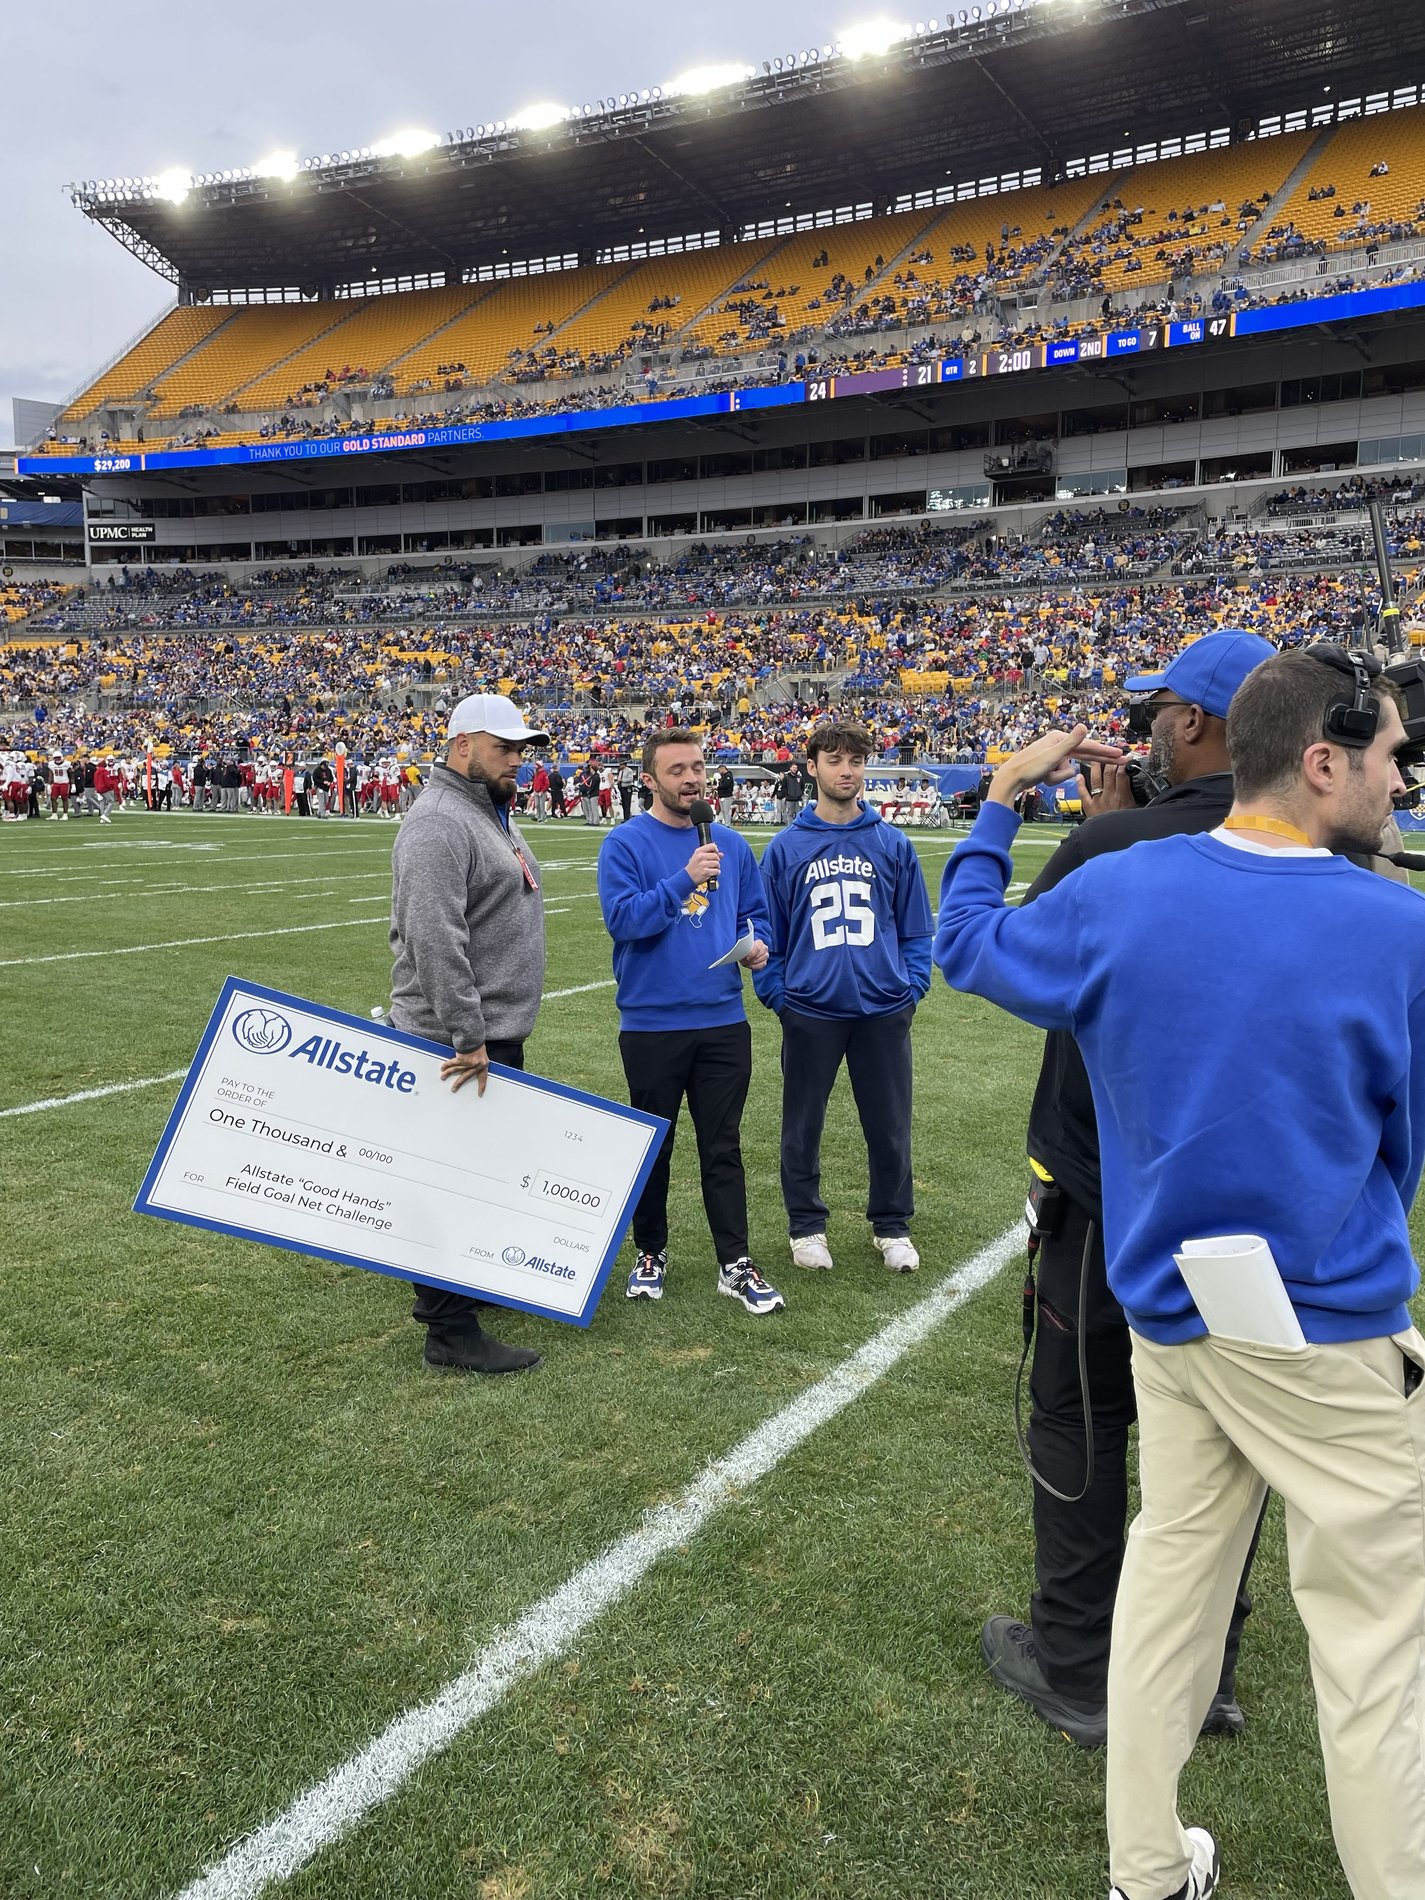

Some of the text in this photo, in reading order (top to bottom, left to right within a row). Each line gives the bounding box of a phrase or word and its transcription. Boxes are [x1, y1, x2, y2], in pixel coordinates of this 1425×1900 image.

[1182, 322, 1200, 334] BALL
[1190, 331, 1200, 340] ON
[1209, 319, 1227, 335] 47
[1118, 331, 1158, 347] TO GO 7
[1053, 341, 1101, 358] DOWN 2ND
[945, 360, 976, 375] QTR 2
[999, 351, 1031, 373] 2:00
[918, 365, 932, 384] 21
[810, 382, 827, 400] 24
[249, 427, 484, 460] THANK YOU TO OUR GOLD STANDARD PARTNERS.
[94, 459, 130, 472] $29,200
[90, 526, 128, 539] UPMC
[810, 879, 875, 950] 25
[288, 1035, 416, 1093] Allstate
[216, 1087, 268, 1108] ORDER OF
[221, 1077, 275, 1100] PAY TO THE
[209, 1108, 393, 1165] One Thousand & 00/100
[563, 1130, 584, 1142] 1234
[183, 1171, 205, 1184] FOR
[240, 1163, 295, 1187] Allstate
[519, 1174, 601, 1208] $ 1,000.00
[225, 1176, 393, 1231] Field Goal Net Challenge
[553, 1236, 591, 1253] DOLLARS
[469, 1246, 576, 1280] FROM Allstate
